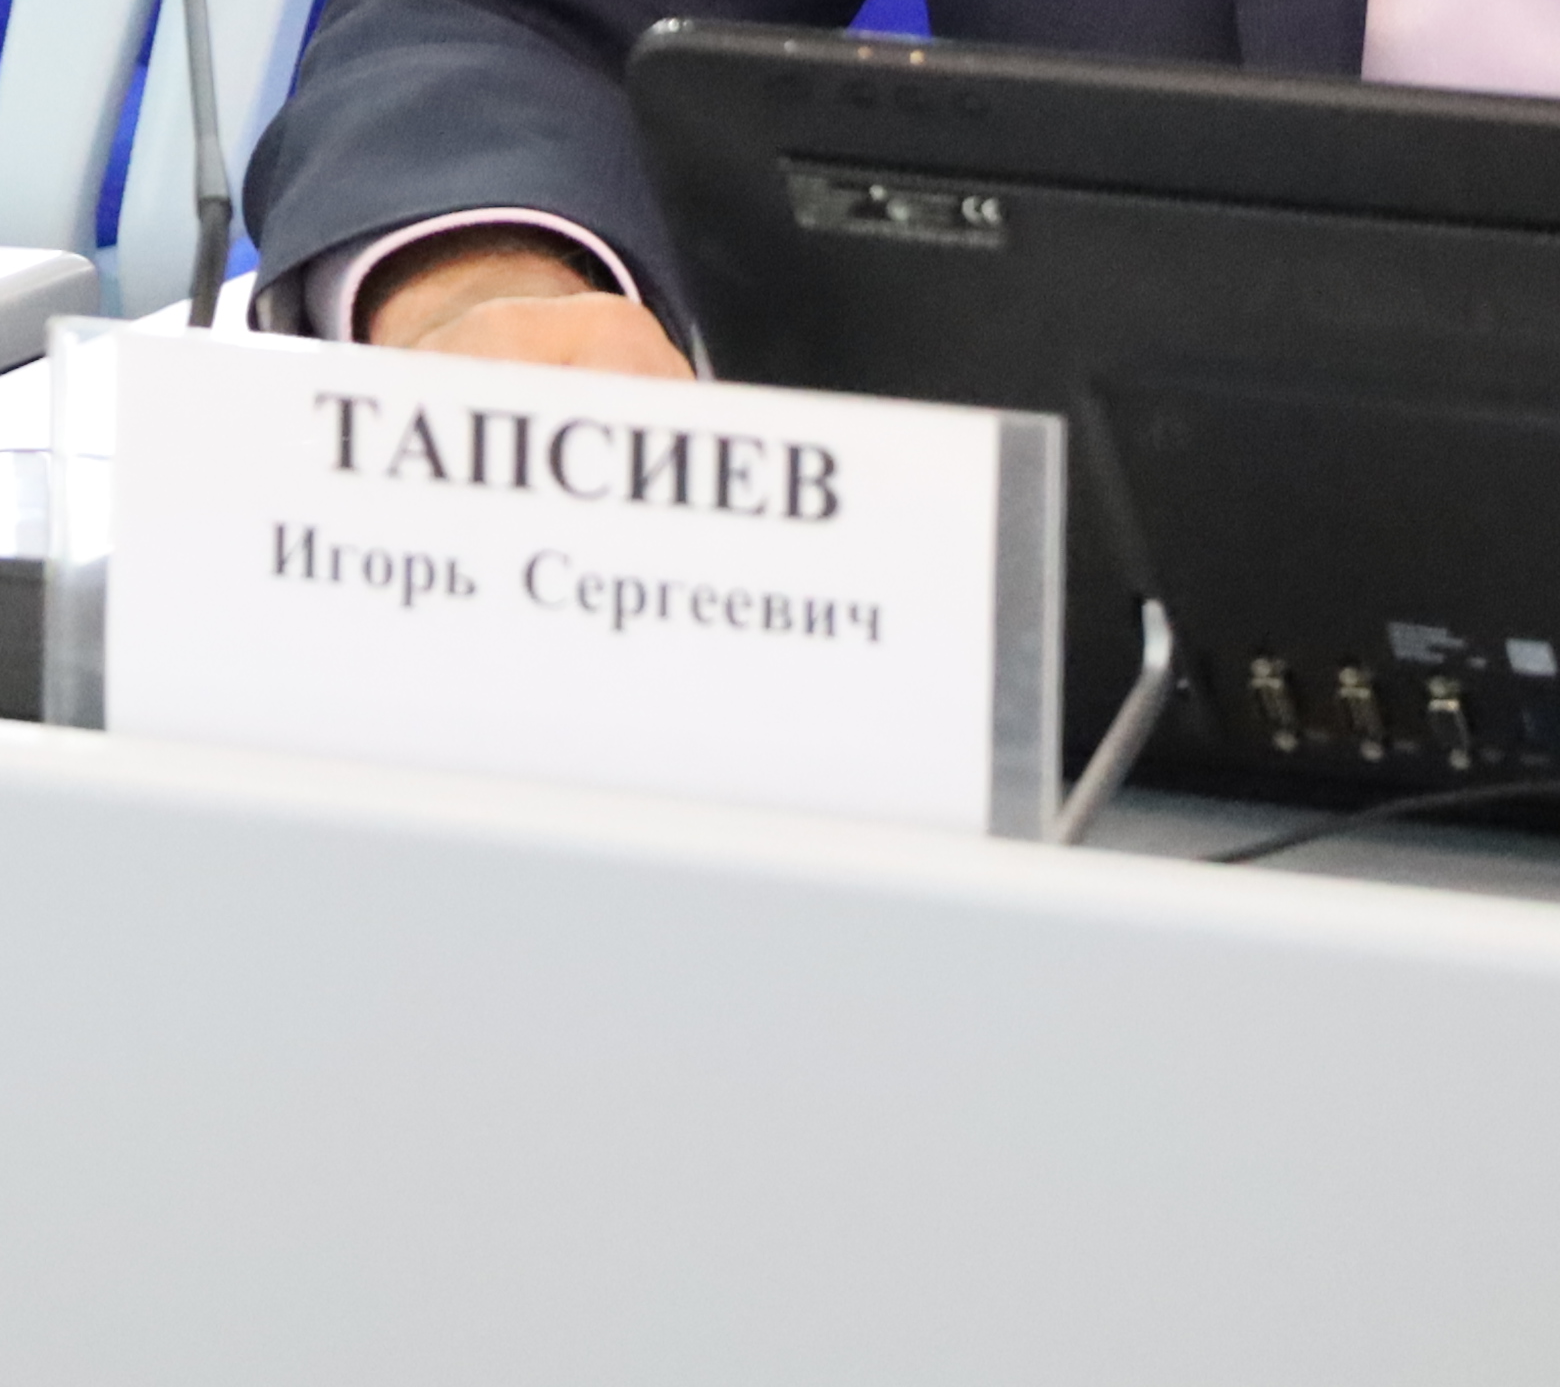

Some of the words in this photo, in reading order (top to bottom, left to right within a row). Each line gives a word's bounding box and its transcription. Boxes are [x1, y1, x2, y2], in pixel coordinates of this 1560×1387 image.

[313, 389, 844, 525] ТАПСИЕВ
[269, 520, 480, 611] Игорь
[520, 549, 884, 646] Сергеевич
